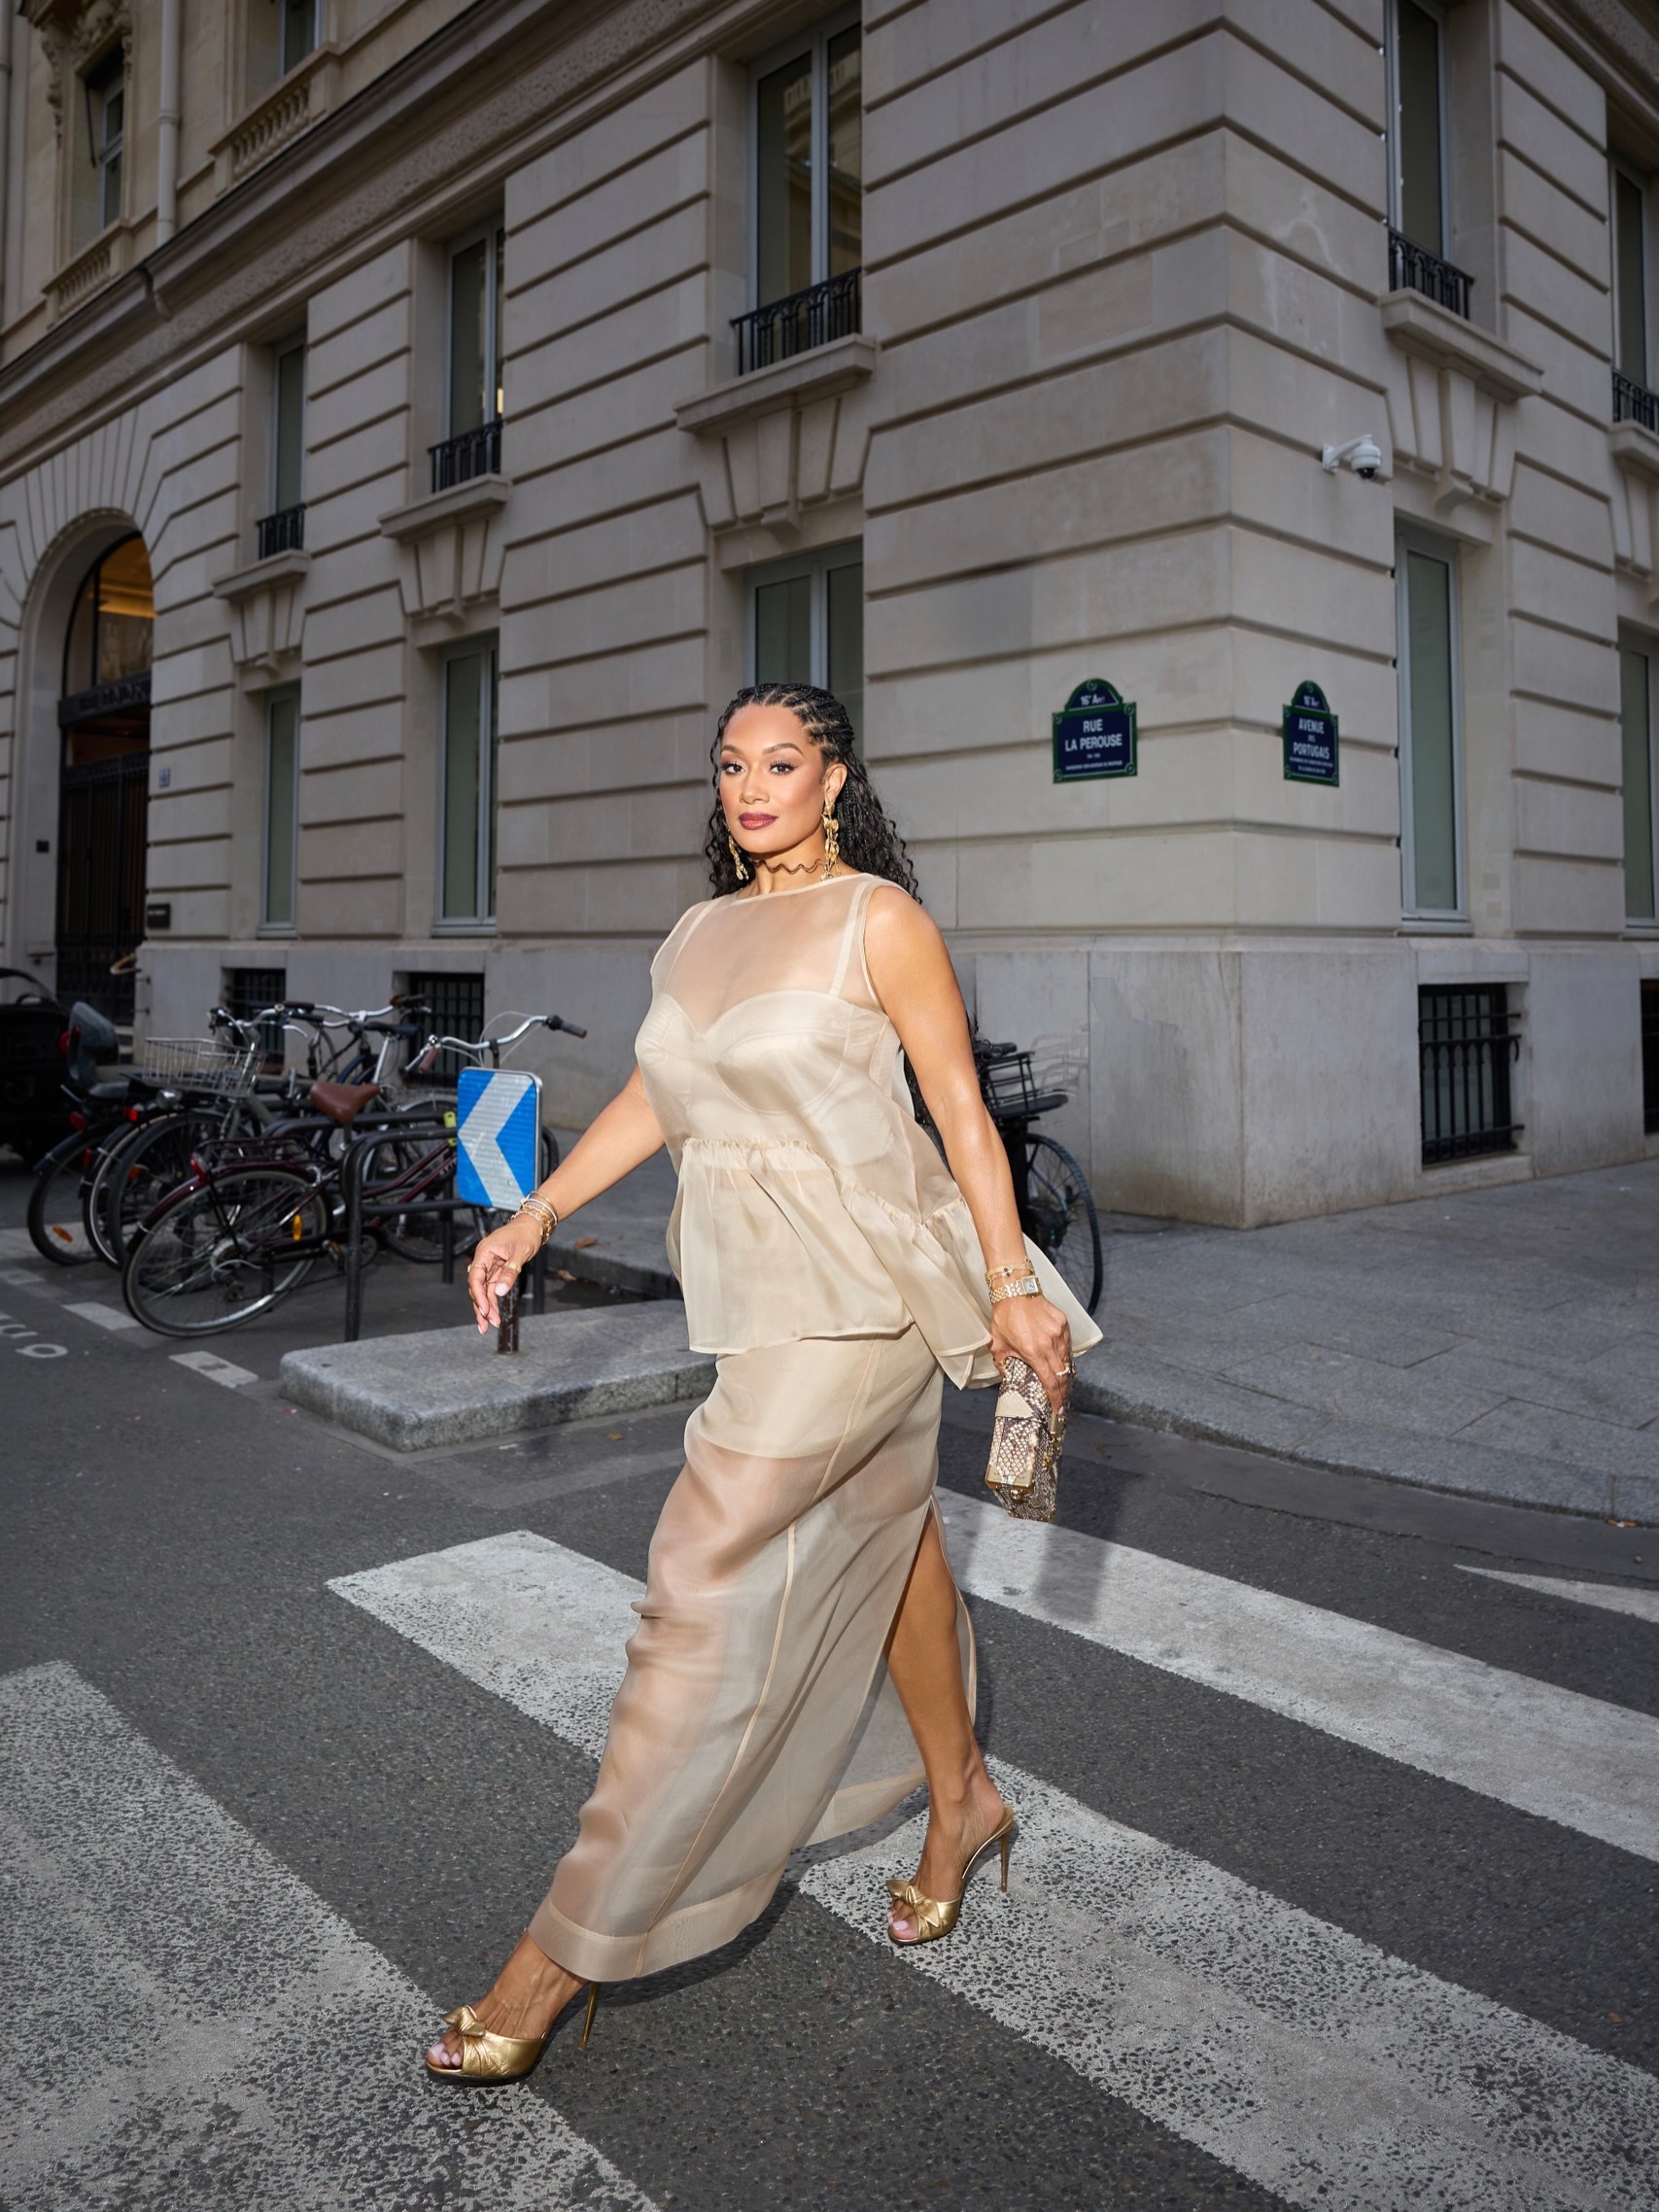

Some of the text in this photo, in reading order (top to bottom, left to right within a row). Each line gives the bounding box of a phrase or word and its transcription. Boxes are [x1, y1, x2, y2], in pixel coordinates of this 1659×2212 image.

[1083, 718, 1103, 733] RUE
[1298, 717, 1324, 734] AVENUE
[1064, 734, 1123, 752] LA PEROUSE
[1293, 742, 1330, 759] PORTUGAIS
